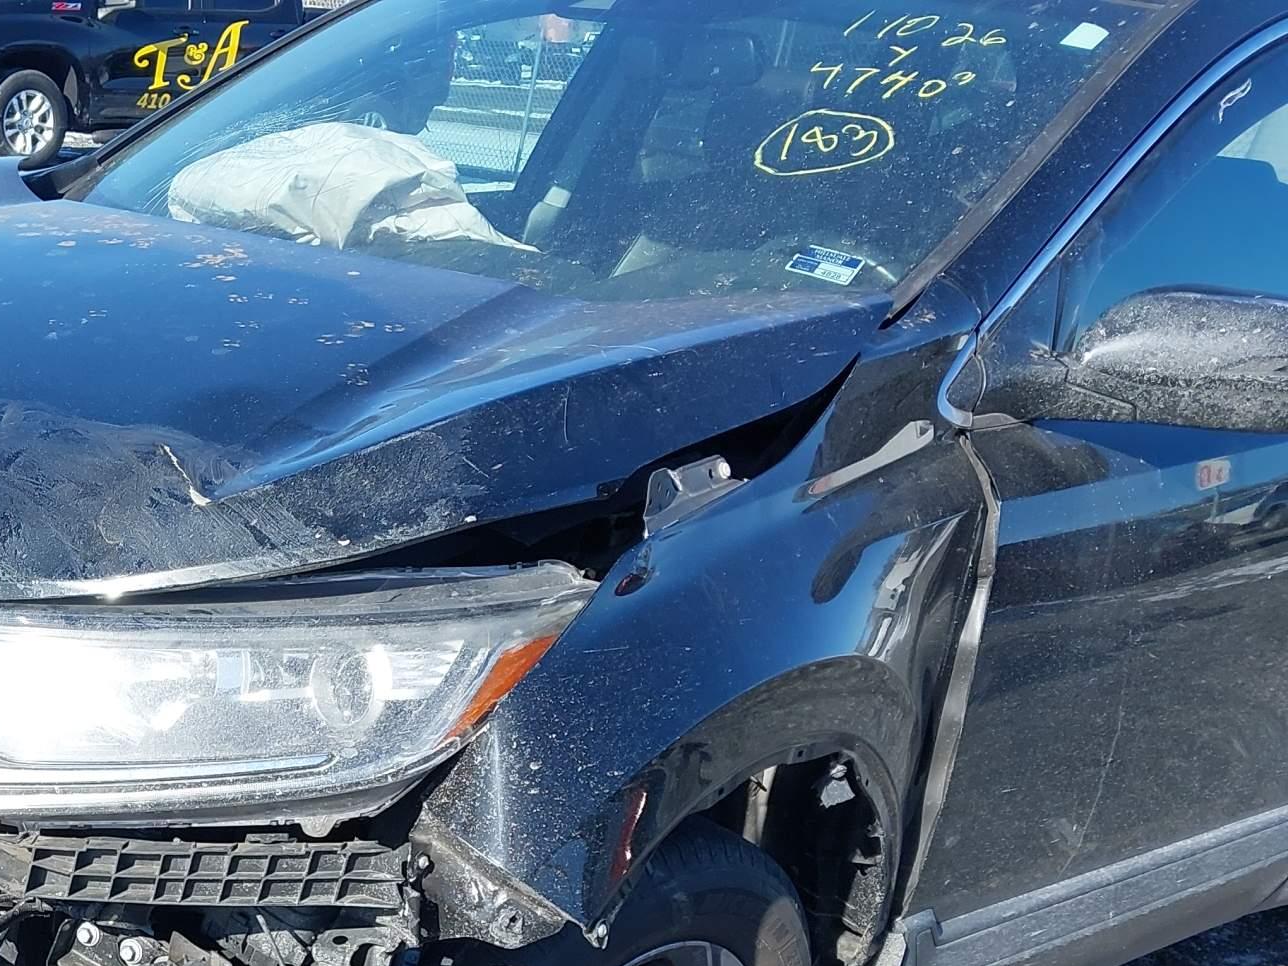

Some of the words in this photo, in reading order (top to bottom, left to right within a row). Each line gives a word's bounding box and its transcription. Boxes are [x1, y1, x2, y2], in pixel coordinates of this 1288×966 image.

[942, 23, 1007, 46] 26
[136, 92, 171, 110] 410
[780, 122, 878, 160] 183
